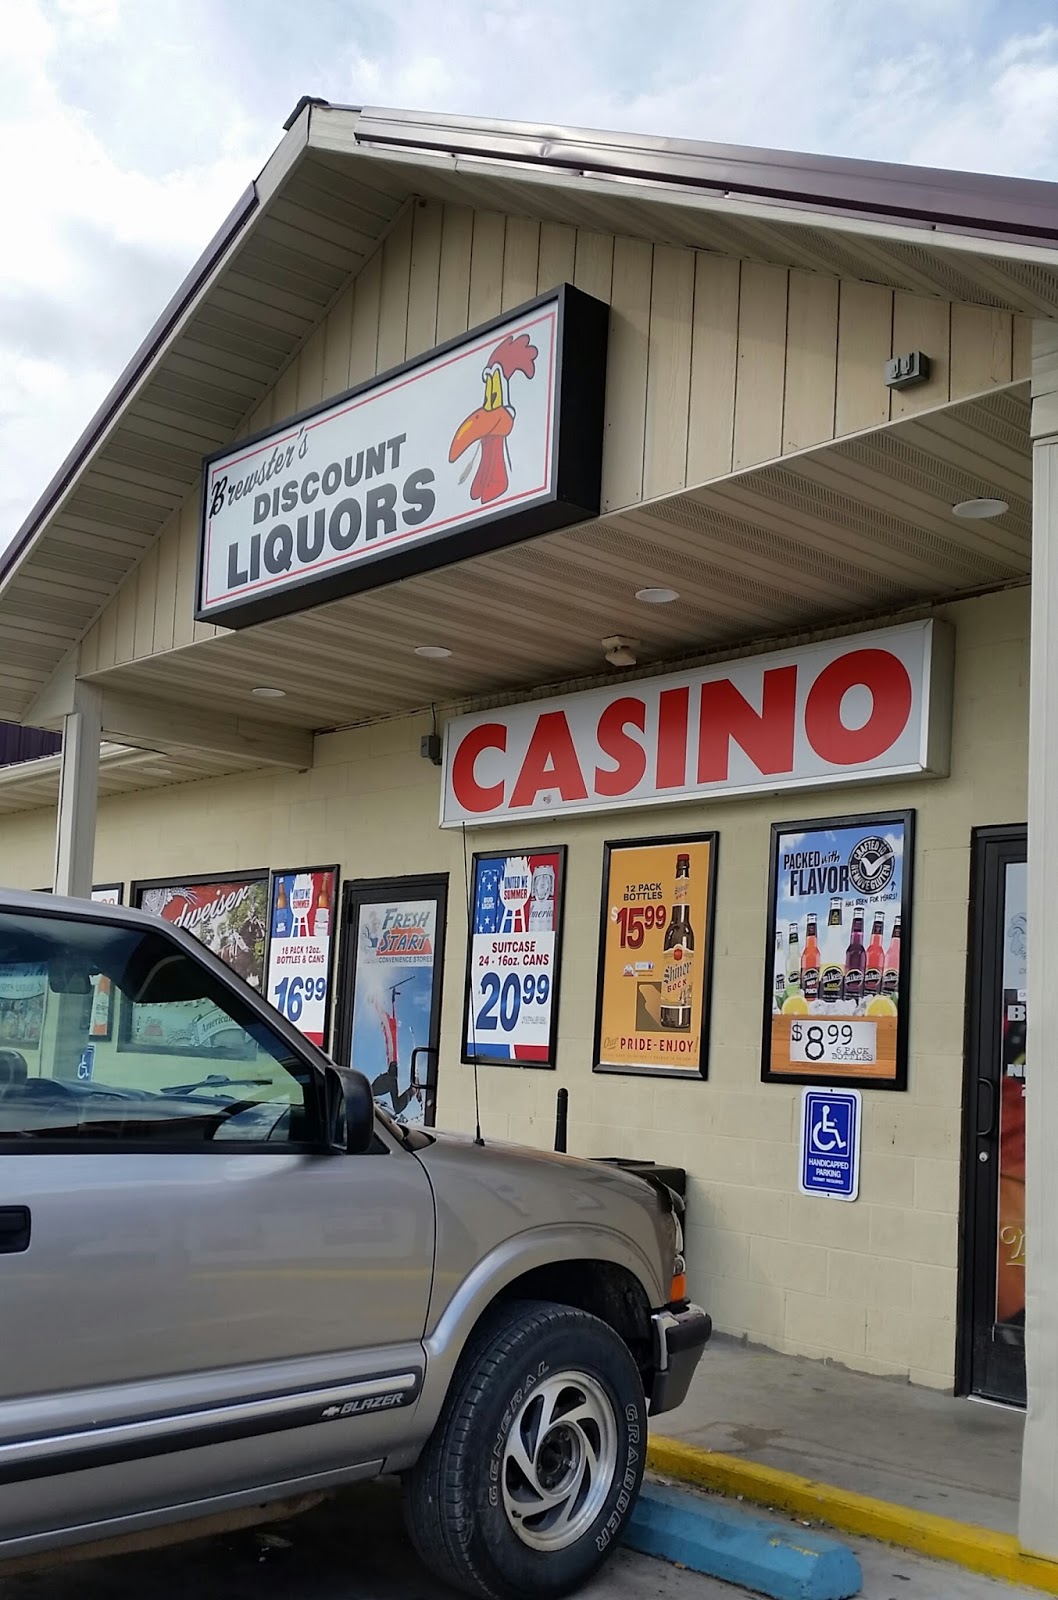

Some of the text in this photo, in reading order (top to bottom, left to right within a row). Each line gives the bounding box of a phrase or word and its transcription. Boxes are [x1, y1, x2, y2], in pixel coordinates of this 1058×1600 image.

[208, 426, 309, 519] Brewster's
[253, 433, 407, 525] DISCOUNT
[227, 467, 436, 590] LIQUORS
[452, 648, 912, 813] CASINO
[784, 850, 841, 870] PACKED with
[854, 840, 888, 860] CRAFTED TO
[790, 865, 849, 896] FLAVOR
[851, 864, 891, 890] REMOVE GLUTEN
[504, 889, 527, 900] SUMMER
[624, 892, 662, 901] BOTTLES
[626, 883, 662, 893] 12 PACK
[171, 885, 249, 929] dweiser
[382, 908, 430, 930] FRESH
[290, 946, 304, 954] PACK
[380, 930, 430, 951] START
[492, 941, 536, 953] SUITCASE
[277, 956, 300, 964] BOTTLES
[308, 955, 324, 963] CANS
[479, 955, 489, 966] 24
[523, 954, 549, 965] CANS
[832, 1052, 873, 1061] BOTTLES
[844, 1046, 869, 1055] PACK
[808, 1158, 849, 1170] HANDICAPPED
[816, 1167, 842, 1178] PARKING
[340, 1392, 404, 1414] BLAZER
[489, 1361, 549, 1506] GENERAL
[595, 1403, 640, 1552] GRABBER
